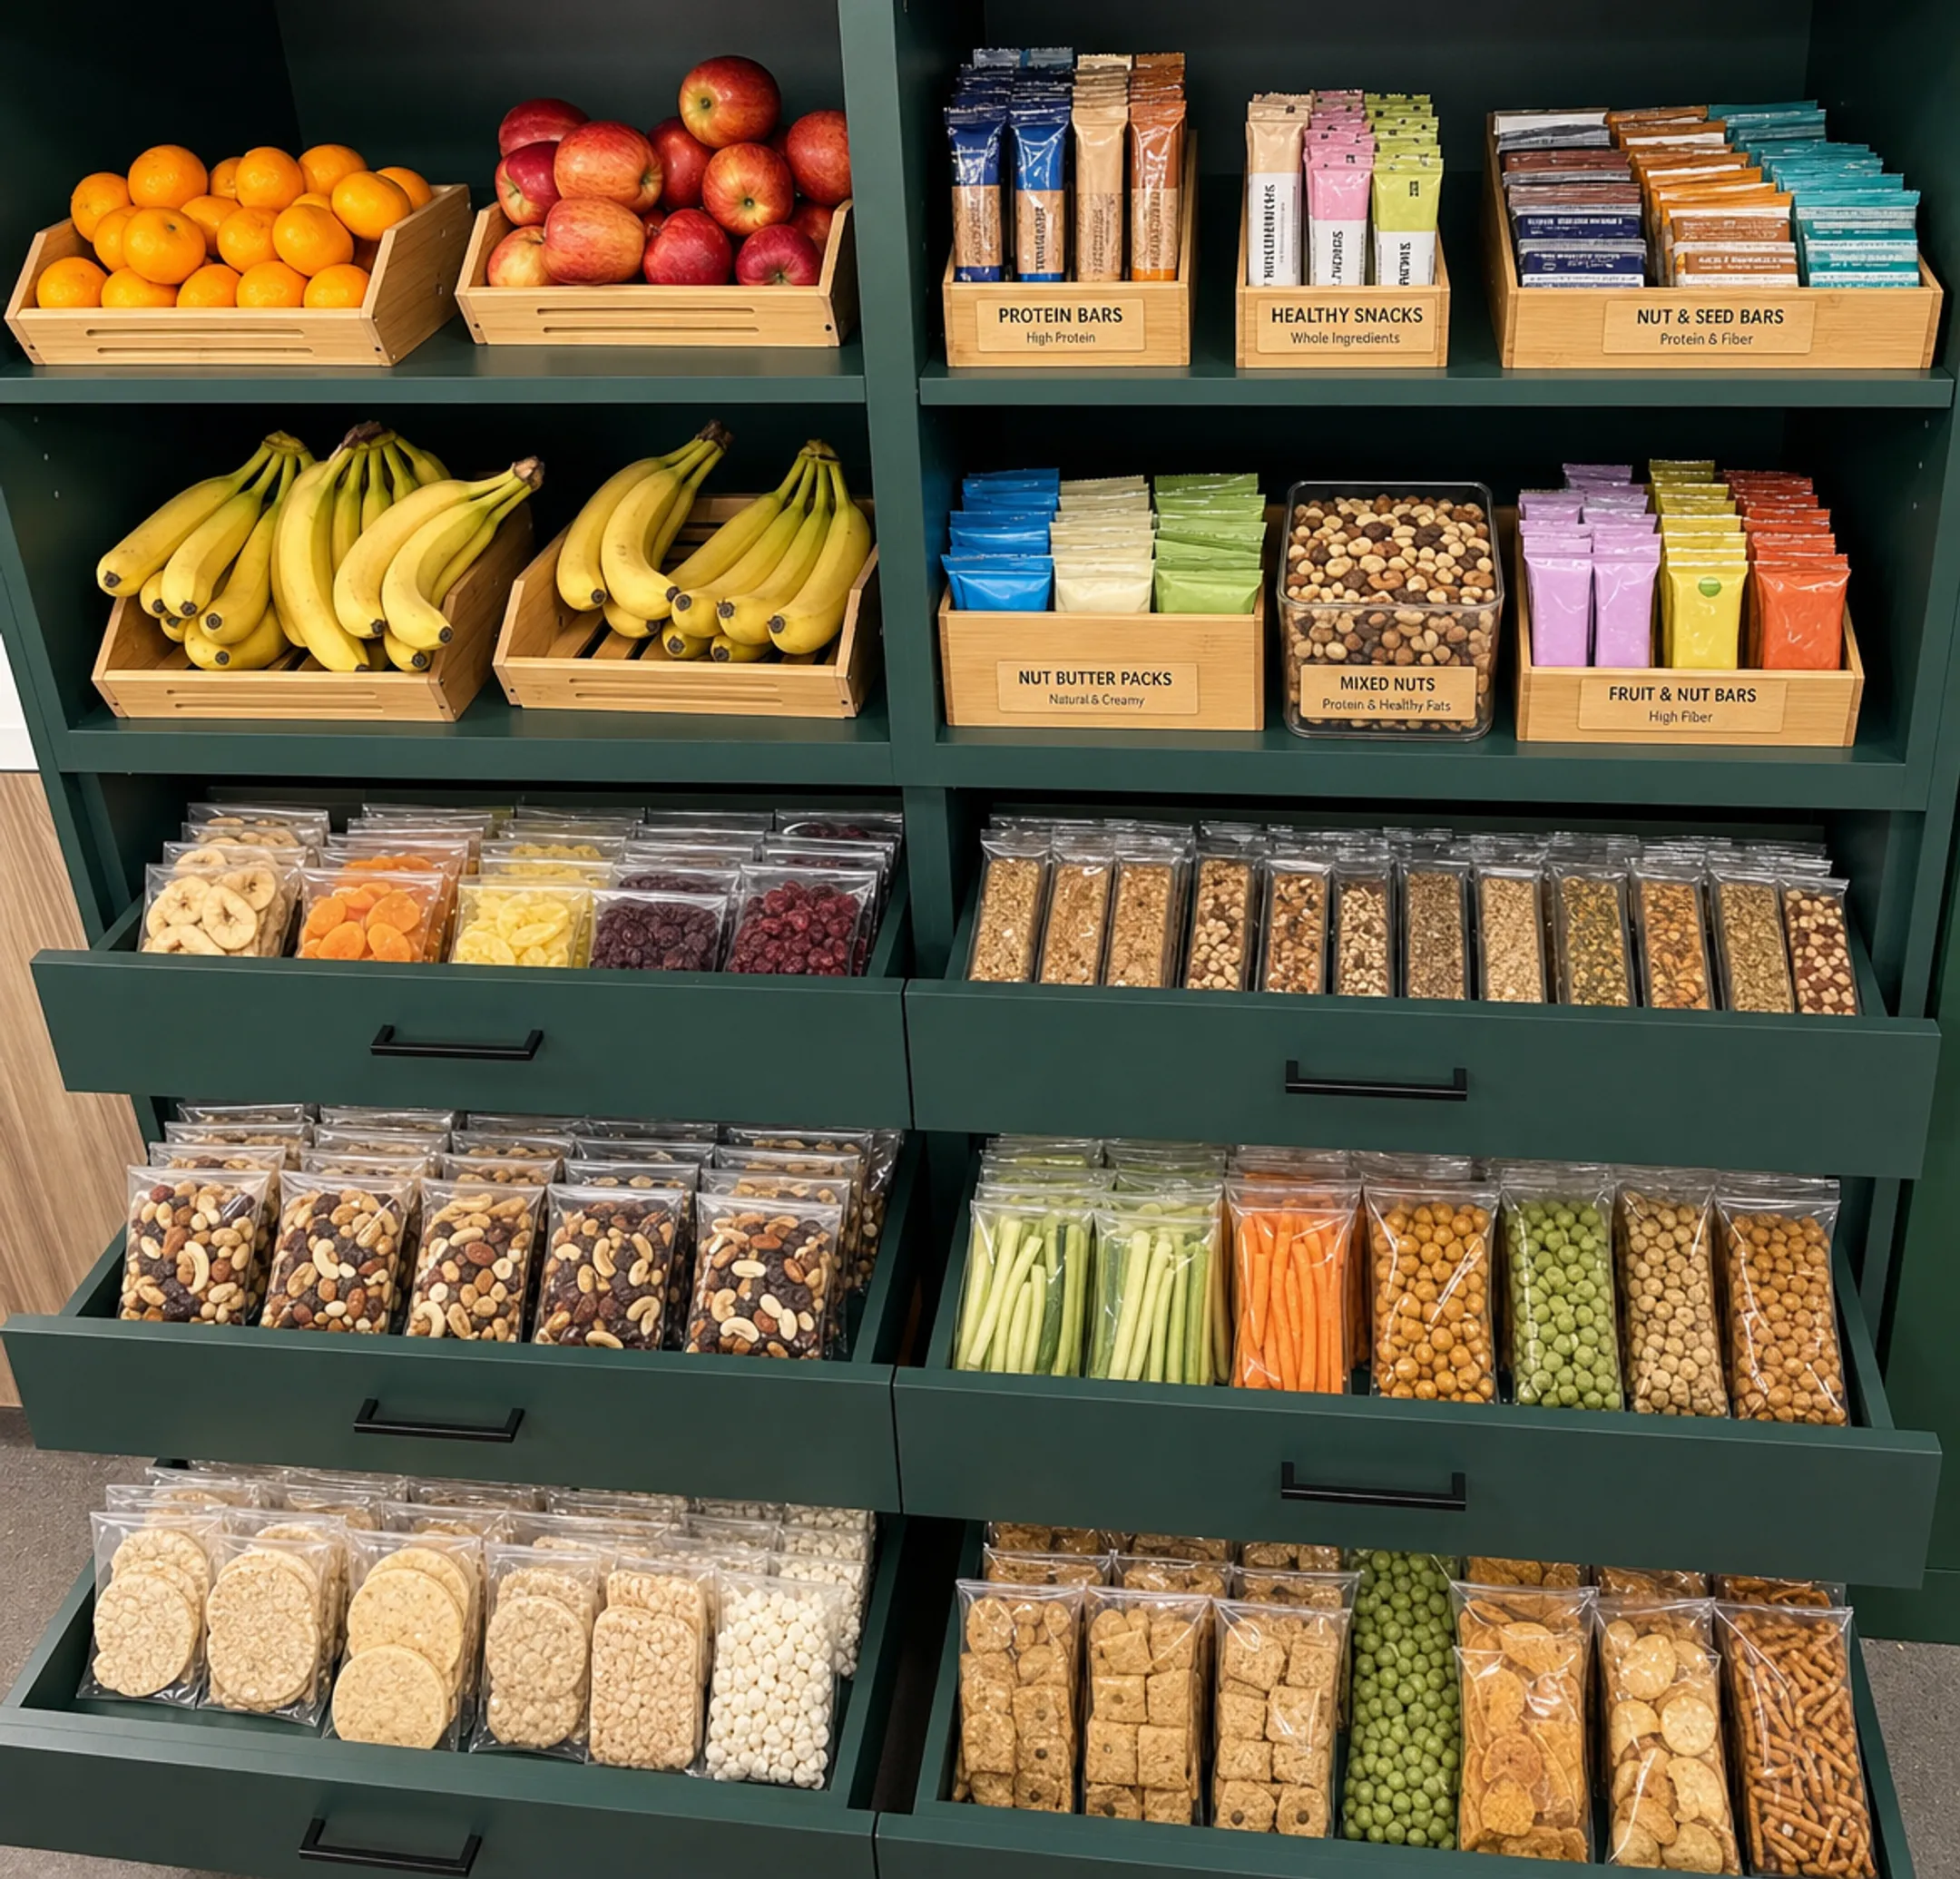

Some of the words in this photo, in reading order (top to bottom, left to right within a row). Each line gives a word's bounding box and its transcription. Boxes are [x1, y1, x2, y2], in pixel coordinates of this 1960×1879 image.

[998, 307, 1072, 324] PROTEIN
[1077, 307, 1123, 324] BARS
[1271, 307, 1350, 324] HEALTHY
[1354, 307, 1424, 324] SNACKS
[1637, 308, 1673, 325] NUT
[1677, 308, 1690, 325] &
[1695, 308, 1735, 325] SEED
[1740, 308, 1785, 325] BARS
[1026, 331, 1054, 347] High
[1055, 331, 1096, 345] Protein
[1290, 331, 1329, 345] Whole
[1332, 331, 1400, 347] Ingredients
[1660, 332, 1705, 346] Protein
[1708, 332, 1718, 346] &
[1721, 332, 1754, 346] Fiber
[1018, 670, 1052, 686] NUT
[1055, 670, 1116, 686] BUTTER
[1121, 670, 1172, 687] PACKS
[1340, 675, 1389, 692] MIXED
[1394, 676, 1436, 692] NUTS
[1048, 693, 1089, 706] Natural
[1090, 693, 1100, 706] &
[1102, 693, 1145, 709] Creamy
[1609, 686, 1656, 702] FRUIT
[1659, 686, 1672, 702] &
[1677, 687, 1711, 702] NUT
[1714, 687, 1757, 703] BARS
[1322, 698, 1365, 711] Protein
[1367, 699, 1377, 711] &
[1379, 698, 1424, 713] Healthy
[1426, 699, 1451, 712] Fats
[1649, 710, 1678, 726] High
[1681, 710, 1713, 723] Fiber
